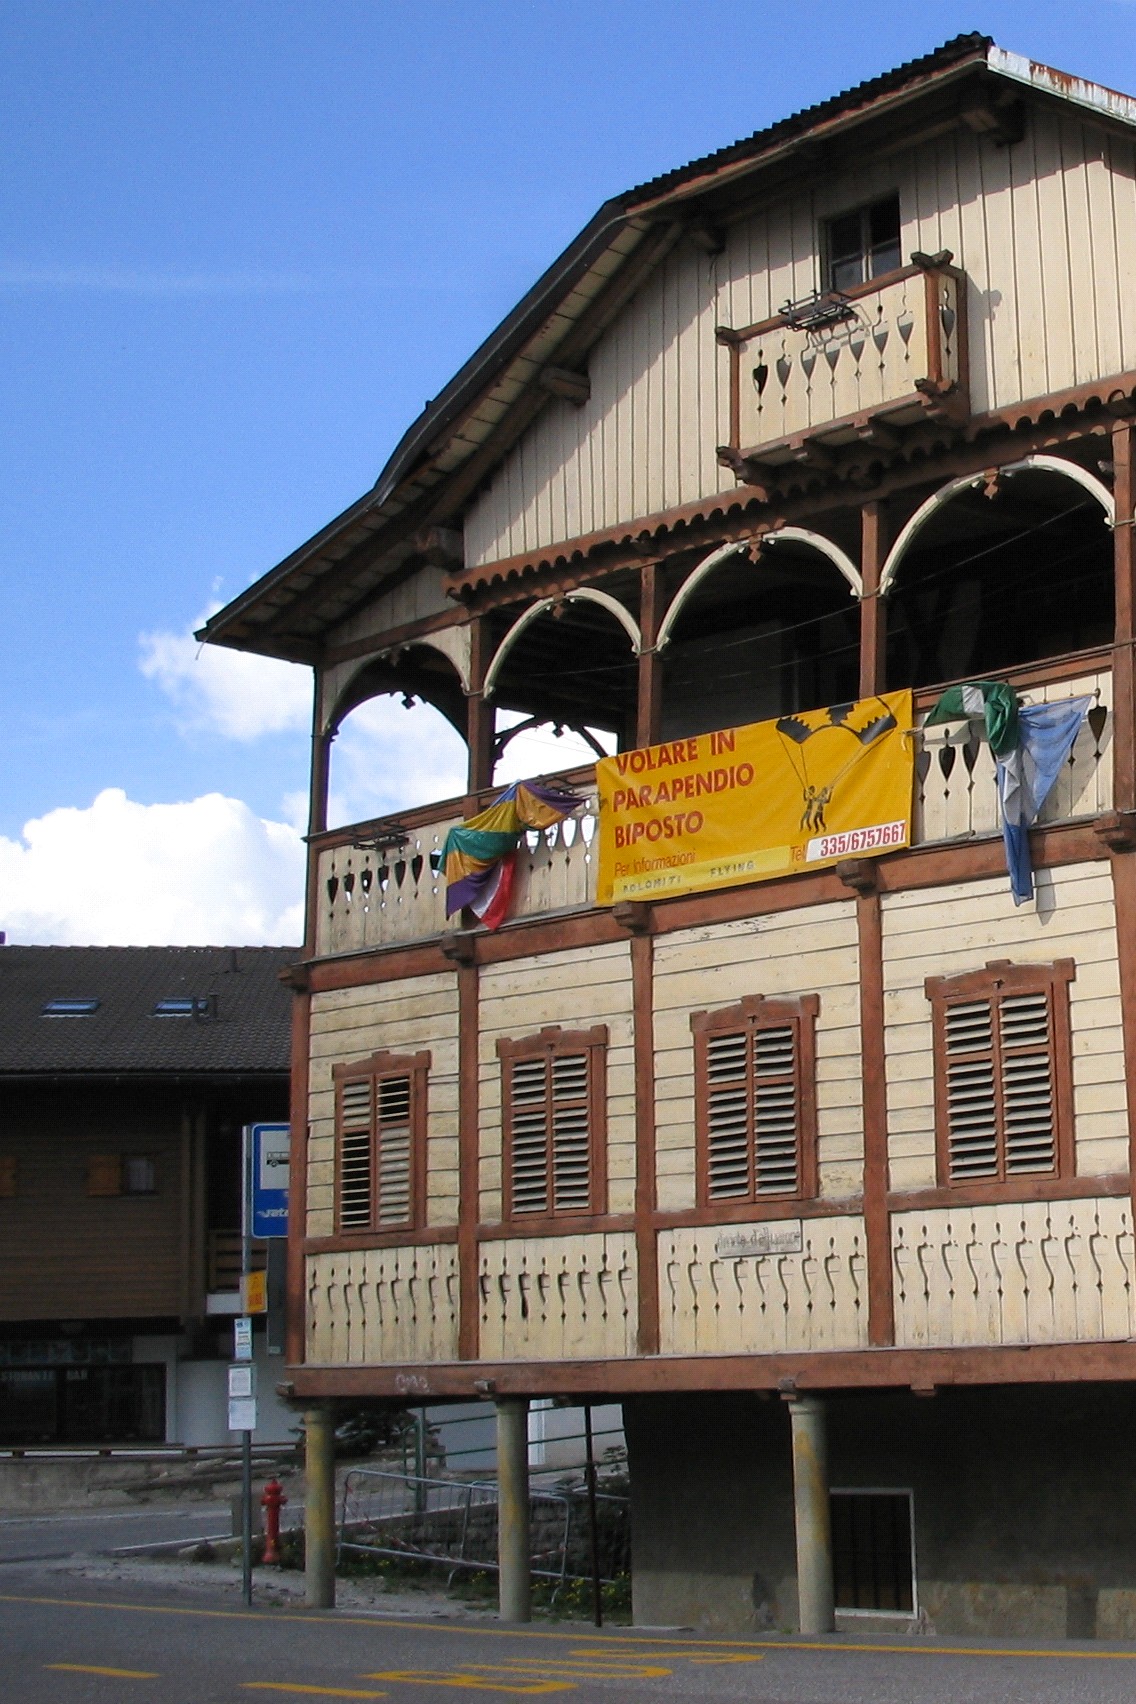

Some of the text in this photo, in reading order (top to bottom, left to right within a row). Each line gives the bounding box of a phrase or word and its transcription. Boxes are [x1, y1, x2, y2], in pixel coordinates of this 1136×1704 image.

[615, 730, 735, 776] VOLARE IN
[613, 763, 754, 812] PARAPENDIO
[615, 810, 704, 848] BIPOSTO
[820, 822, 907, 857] 335/6757667
[614, 861, 630, 877] Per
[709, 860, 756, 878] FLYING
[355, 1648, 765, 1694] BUS
